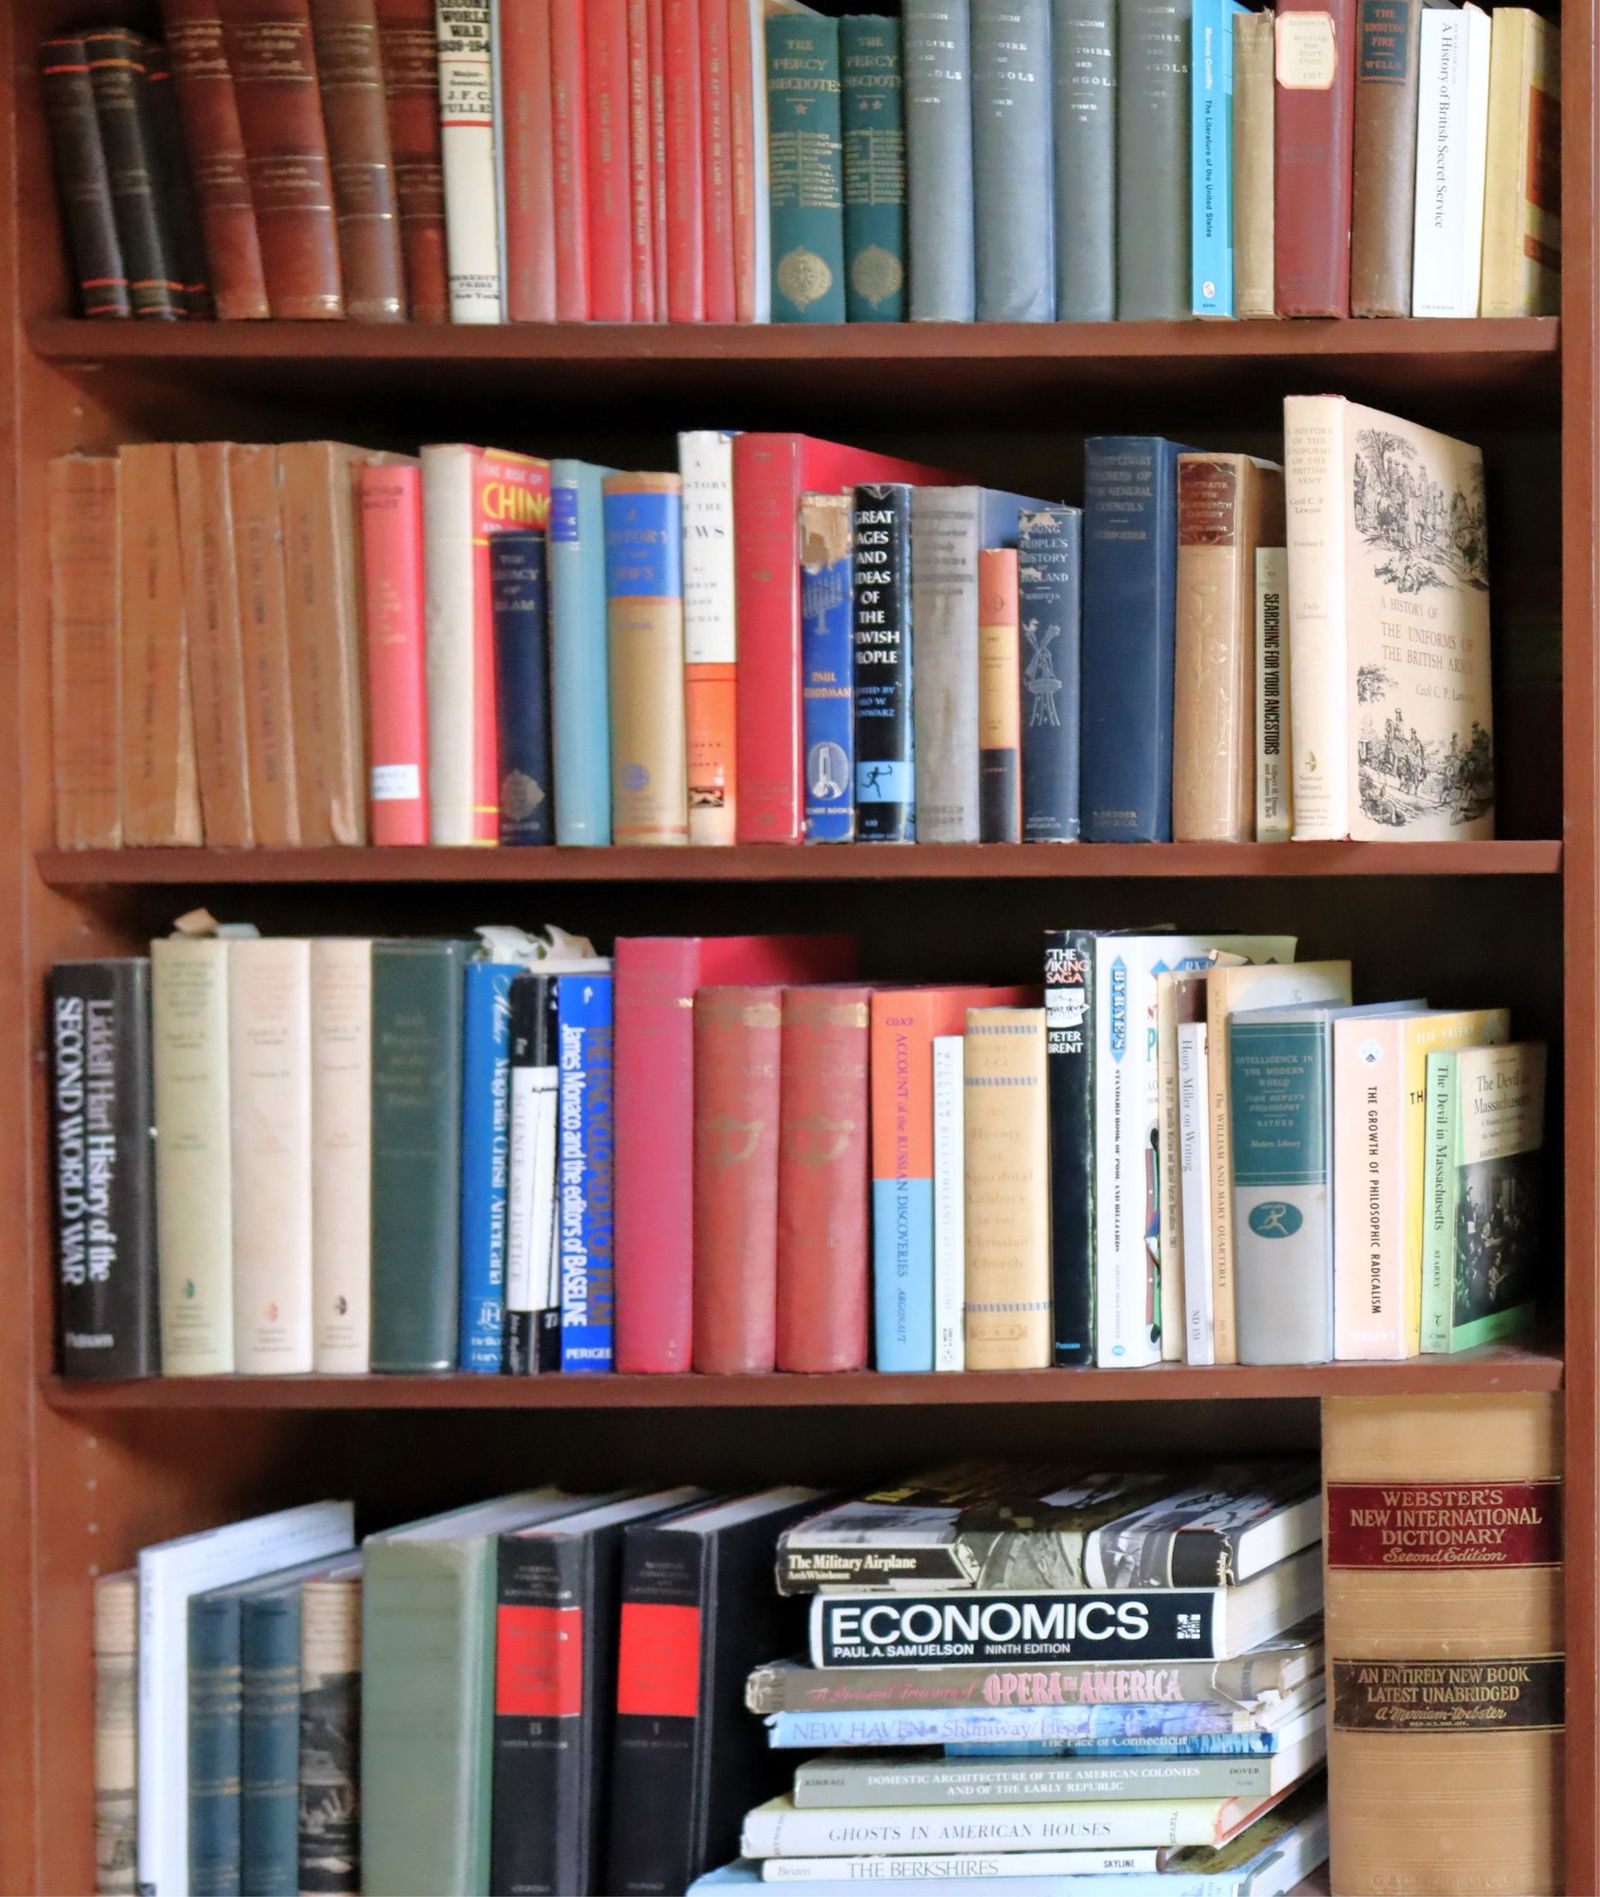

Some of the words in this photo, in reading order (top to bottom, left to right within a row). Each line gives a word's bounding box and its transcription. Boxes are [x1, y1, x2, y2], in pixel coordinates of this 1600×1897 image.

[1375, 8, 1396, 18] THE
[450, 26, 483, 37] WAR
[1365, 22, 1405, 32] UNDYING
[1442, 23, 1453, 32] A
[786, 40, 814, 50] THE
[1371, 36, 1395, 47] FIRE
[773, 58, 829, 71] PERCY
[1438, 36, 1453, 82] History
[1440, 86, 1451, 100] of
[1437, 102, 1451, 142] British
[1205, 117, 1213, 155] Literature
[1206, 158, 1212, 166] of
[1436, 145, 1450, 182] Secret
[1434, 185, 1448, 229] Service
[482, 482, 551, 523] CHIN
[857, 530, 890, 544] AGES
[857, 550, 888, 564] AND
[861, 590, 880, 604] OF
[859, 611, 886, 624] THE
[1264, 593, 1280, 648] SEARCHING
[855, 631, 901, 645] EWISH
[1381, 622, 1402, 639] THE
[1408, 626, 1456, 650] UNIFORMS
[1264, 651, 1279, 668] FOR
[1382, 644, 1402, 662] THE
[1407, 649, 1443, 670] BRITISH
[1264, 670, 1279, 697] YOUR
[1264, 699, 1280, 755] ANCESTORS
[1049, 948, 1077, 961] THE
[1046, 971, 1084, 984] SAGA
[1112, 969, 1126, 1050] BYRNE'S
[88, 999, 115, 1075] Liddell
[561, 1023, 586, 1070] James
[588, 1024, 613, 1064] THE
[1049, 1031, 1082, 1042] PETER
[55, 997, 84, 1111] SECOND
[896, 1034, 908, 1099] ACCOUNT
[1182, 1040, 1193, 1072] Henry
[1259, 1079, 1290, 1087] WORLD
[1266, 1067, 1304, 1075] MODERN
[1437, 1065, 1449, 1088] The
[88, 1079, 115, 1131] Hart
[491, 1057, 510, 1131] Magnalia
[562, 1072, 586, 1129] Monaco
[1184, 1078, 1195, 1108] Miller
[1367, 1086, 1378, 1104] THE
[896, 1102, 907, 1115] of
[1184, 1114, 1190, 1127] on
[1436, 1093, 1448, 1125] Devil
[896, 1117, 907, 1132] the
[1217, 1113, 1225, 1159] WILLIAM
[1368, 1110, 1379, 1156] GROWTH
[1436, 1129, 1448, 1140] in
[562, 1131, 586, 1157] and
[588, 1067, 614, 1228] ENCYCLOPEDIA
[1114, 1144, 1120, 1155] OF
[1182, 1131, 1196, 1174] Writing
[57, 1114, 86, 1219] WORLD
[79, 1134, 116, 1215] History
[491, 1136, 509, 1188] Christi
[562, 1160, 586, 1183] the
[897, 1136, 908, 1191] RUSSIAN
[1369, 1161, 1380, 1174] OF
[1217, 1165, 1225, 1187] AND
[1434, 1145, 1448, 1231] Massachusetts
[562, 1185, 587, 1235] editors
[1217, 1191, 1225, 1219] MARY
[1369, 1180, 1381, 1248] PHILOSOPHIC
[88, 1218, 117, 1243] of
[488, 1195, 507, 1285] Americana
[897, 1196, 909, 1278] DISCOVERIES
[62, 1223, 86, 1286] WAR
[562, 1237, 587, 1255] of
[588, 1231, 614, 1263] OF
[1217, 1226, 1225, 1289] QUARTERLY
[89, 1246, 115, 1283] the
[1433, 1250, 1441, 1288] STARKEY
[562, 1255, 587, 1327] BASELINE
[588, 1268, 614, 1326] FILM
[1371, 1254, 1382, 1314] RADICALISM
[897, 1289, 907, 1343] ARGONAUT
[565, 1349, 612, 1360] PERIGEE
[1382, 1489, 1504, 1507] WEBSTER'S
[1351, 1509, 1394, 1527] NEW
[1396, 1507, 1542, 1527] INTERNATIONAL
[1381, 1528, 1505, 1546] DICTIONARY
[788, 1554, 812, 1569] The
[813, 1554, 862, 1571] Military
[864, 1554, 917, 1572] Airplane
[1383, 1547, 1443, 1563] Second
[1443, 1547, 1507, 1562] Edition
[831, 1601, 1149, 1645] ECONOMICS
[833, 1646, 868, 1659] PAUL
[869, 1646, 885, 1657] A.
[887, 1644, 975, 1657] SAMUELSON
[984, 1644, 1021, 1655] NINTH
[1023, 1642, 1071, 1654] EDITION
[982, 1671, 1064, 1705] OPERA
[1079, 1669, 1184, 1702] AMERICA
[1358, 1668, 1377, 1683] AN
[1383, 1667, 1447, 1684] ENTIRELY
[1449, 1667, 1484, 1683] NEW
[1487, 1666, 1530, 1682] BOOK
[1367, 1687, 1419, 1703] LATEST
[1422, 1685, 1520, 1703] UNABRIDGED
[1375, 1706, 1387, 1720] A
[1387, 1706, 1507, 1722] Merriam-Webster
[792, 1722, 843, 1740] NEW
[851, 1720, 926, 1739] HAVEN
[867, 1776, 929, 1786] DOMESTIC
[932, 1772, 1028, 1784] ARCHITECTURE
[1030, 1771, 1046, 1781] OF
[1048, 1771, 1073, 1780] THE
[1076, 1769, 1139, 1779] AMERICAN
[1142, 1767, 1201, 1778] COLONIES
[947, 1786, 974, 1796] AND
[976, 1785, 992, 1795] OF
[996, 1784, 1020, 1794] THE
[1024, 1783, 1061, 1793] EARLY
[1067, 1781, 1124, 1792] REPUBLIC
[829, 1826, 902, 1842] GHOSTS
[911, 1825, 930, 1840] IN
[938, 1823, 1033, 1839] AMERICAN
[1042, 1821, 1111, 1837] HOUSES
[847, 1863, 885, 1879] THE
[890, 1860, 999, 1878] BERKSHIRES
[1103, 1859, 1135, 1868] SKYLINE
